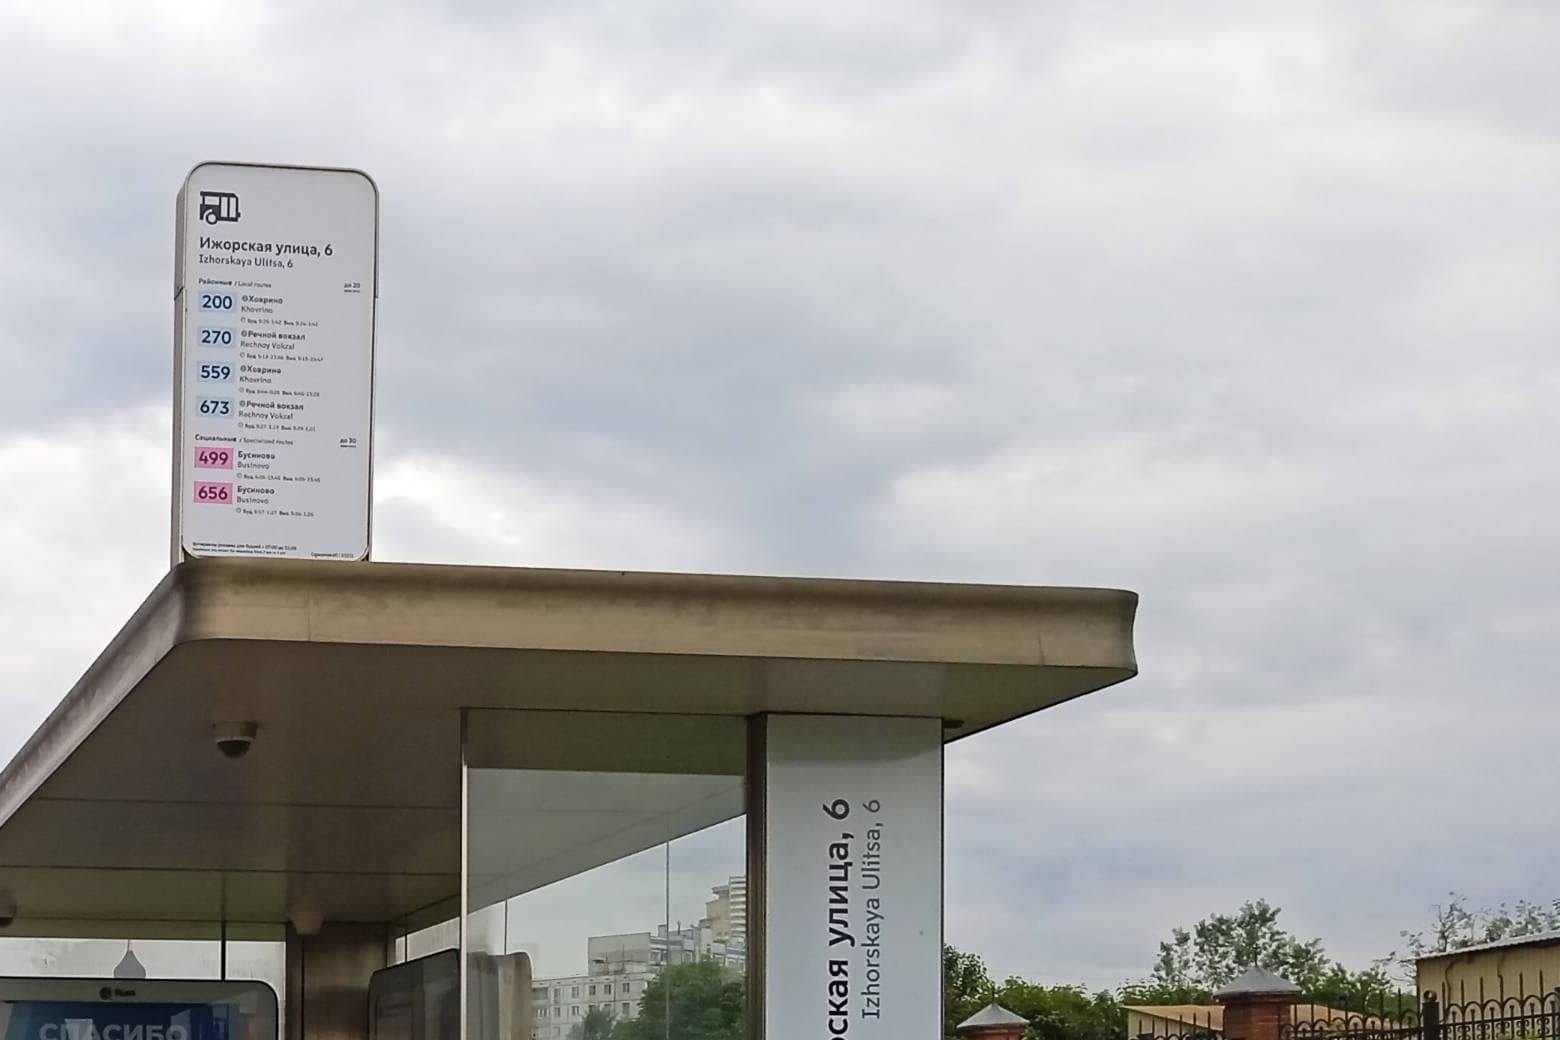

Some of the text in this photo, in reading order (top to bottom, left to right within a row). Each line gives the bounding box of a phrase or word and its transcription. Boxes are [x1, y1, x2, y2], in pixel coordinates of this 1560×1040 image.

[199, 236, 333, 258] Ижорская улица, 6
[199, 254, 294, 269] Izhorskaya Ulitsa, 6
[202, 294, 233, 309] 200
[248, 295, 283, 304] Ховрино
[201, 329, 232, 344] 270
[248, 330, 277, 339] Речной
[200, 365, 231, 379] 559
[200, 399, 229, 414] 673
[246, 400, 304, 411] Речной вокзал
[199, 450, 228, 465] 499
[237, 450, 276, 460] Бусиново
[198, 485, 228, 500] 656
[237, 485, 275, 495] Бусиново
[822, 798, 850, 820] 6
[828, 832, 855, 947] улица,
[861, 799, 884, 1020] Izhorskaya Ulitsa, 6
